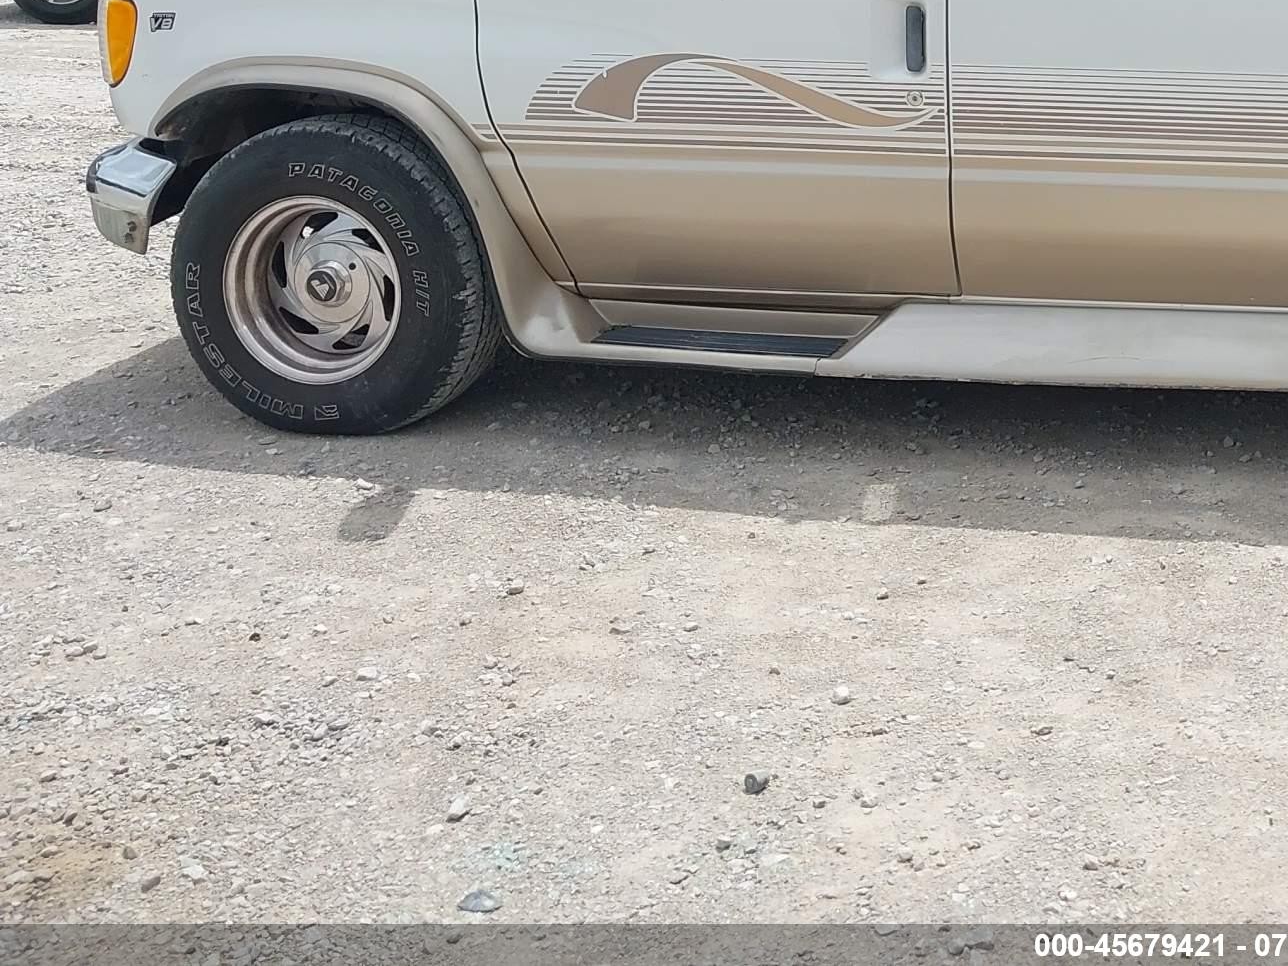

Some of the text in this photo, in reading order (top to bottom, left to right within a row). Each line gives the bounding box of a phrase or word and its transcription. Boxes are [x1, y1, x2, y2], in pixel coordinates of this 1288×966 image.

[150, 17, 173, 32] V8
[288, 161, 420, 257] PATAGONIA
[184, 261, 305, 421] MILESTAR
